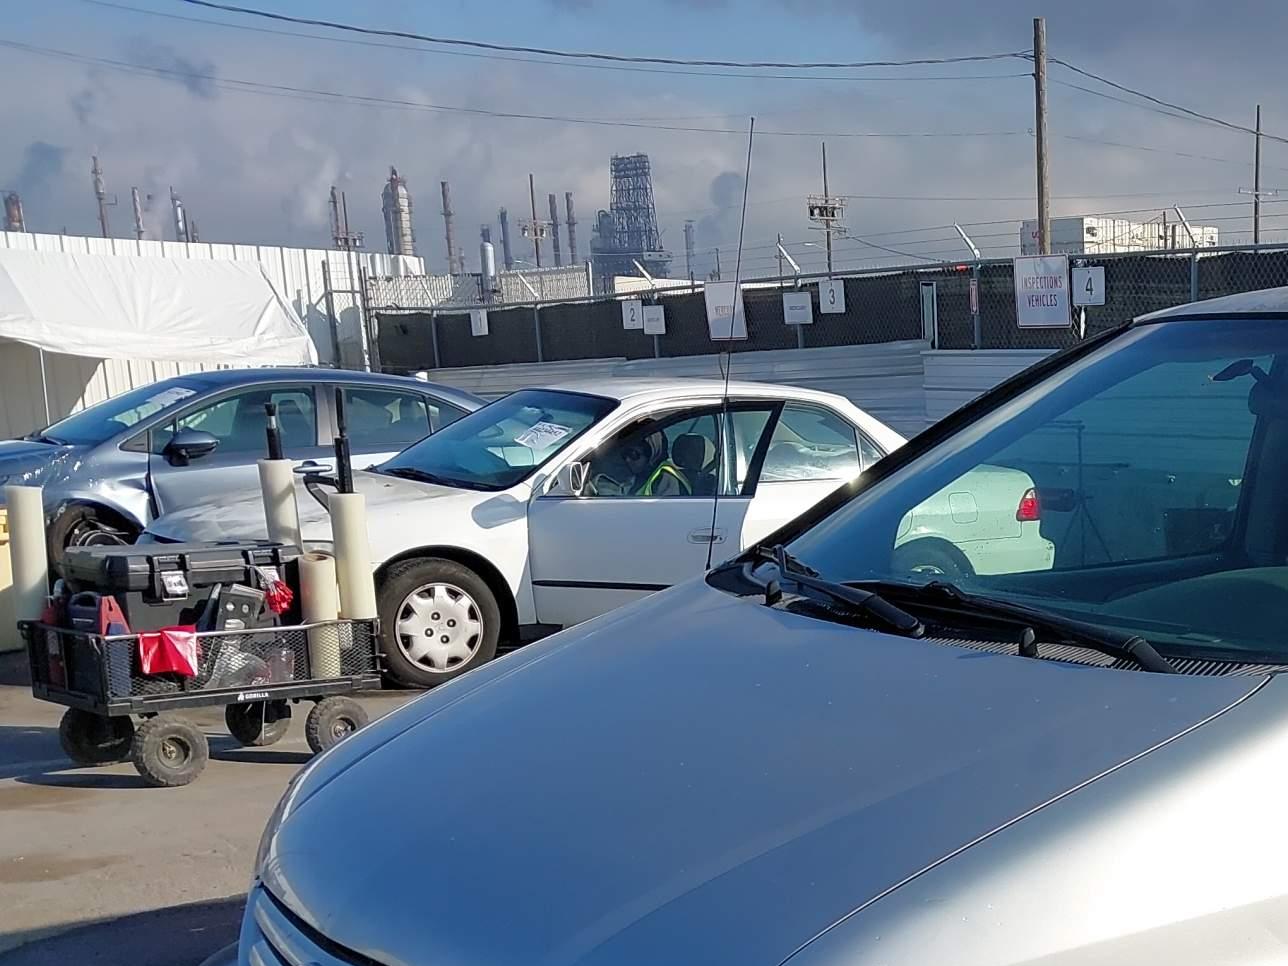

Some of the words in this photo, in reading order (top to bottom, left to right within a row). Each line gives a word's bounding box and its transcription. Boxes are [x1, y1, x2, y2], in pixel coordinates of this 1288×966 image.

[1021, 276, 1063, 289] INSPECTIONS
[1085, 277, 1094, 296] 4
[828, 288, 836, 305] 3
[1027, 294, 1058, 307] VEHICLES
[629, 308, 636, 322] 2
